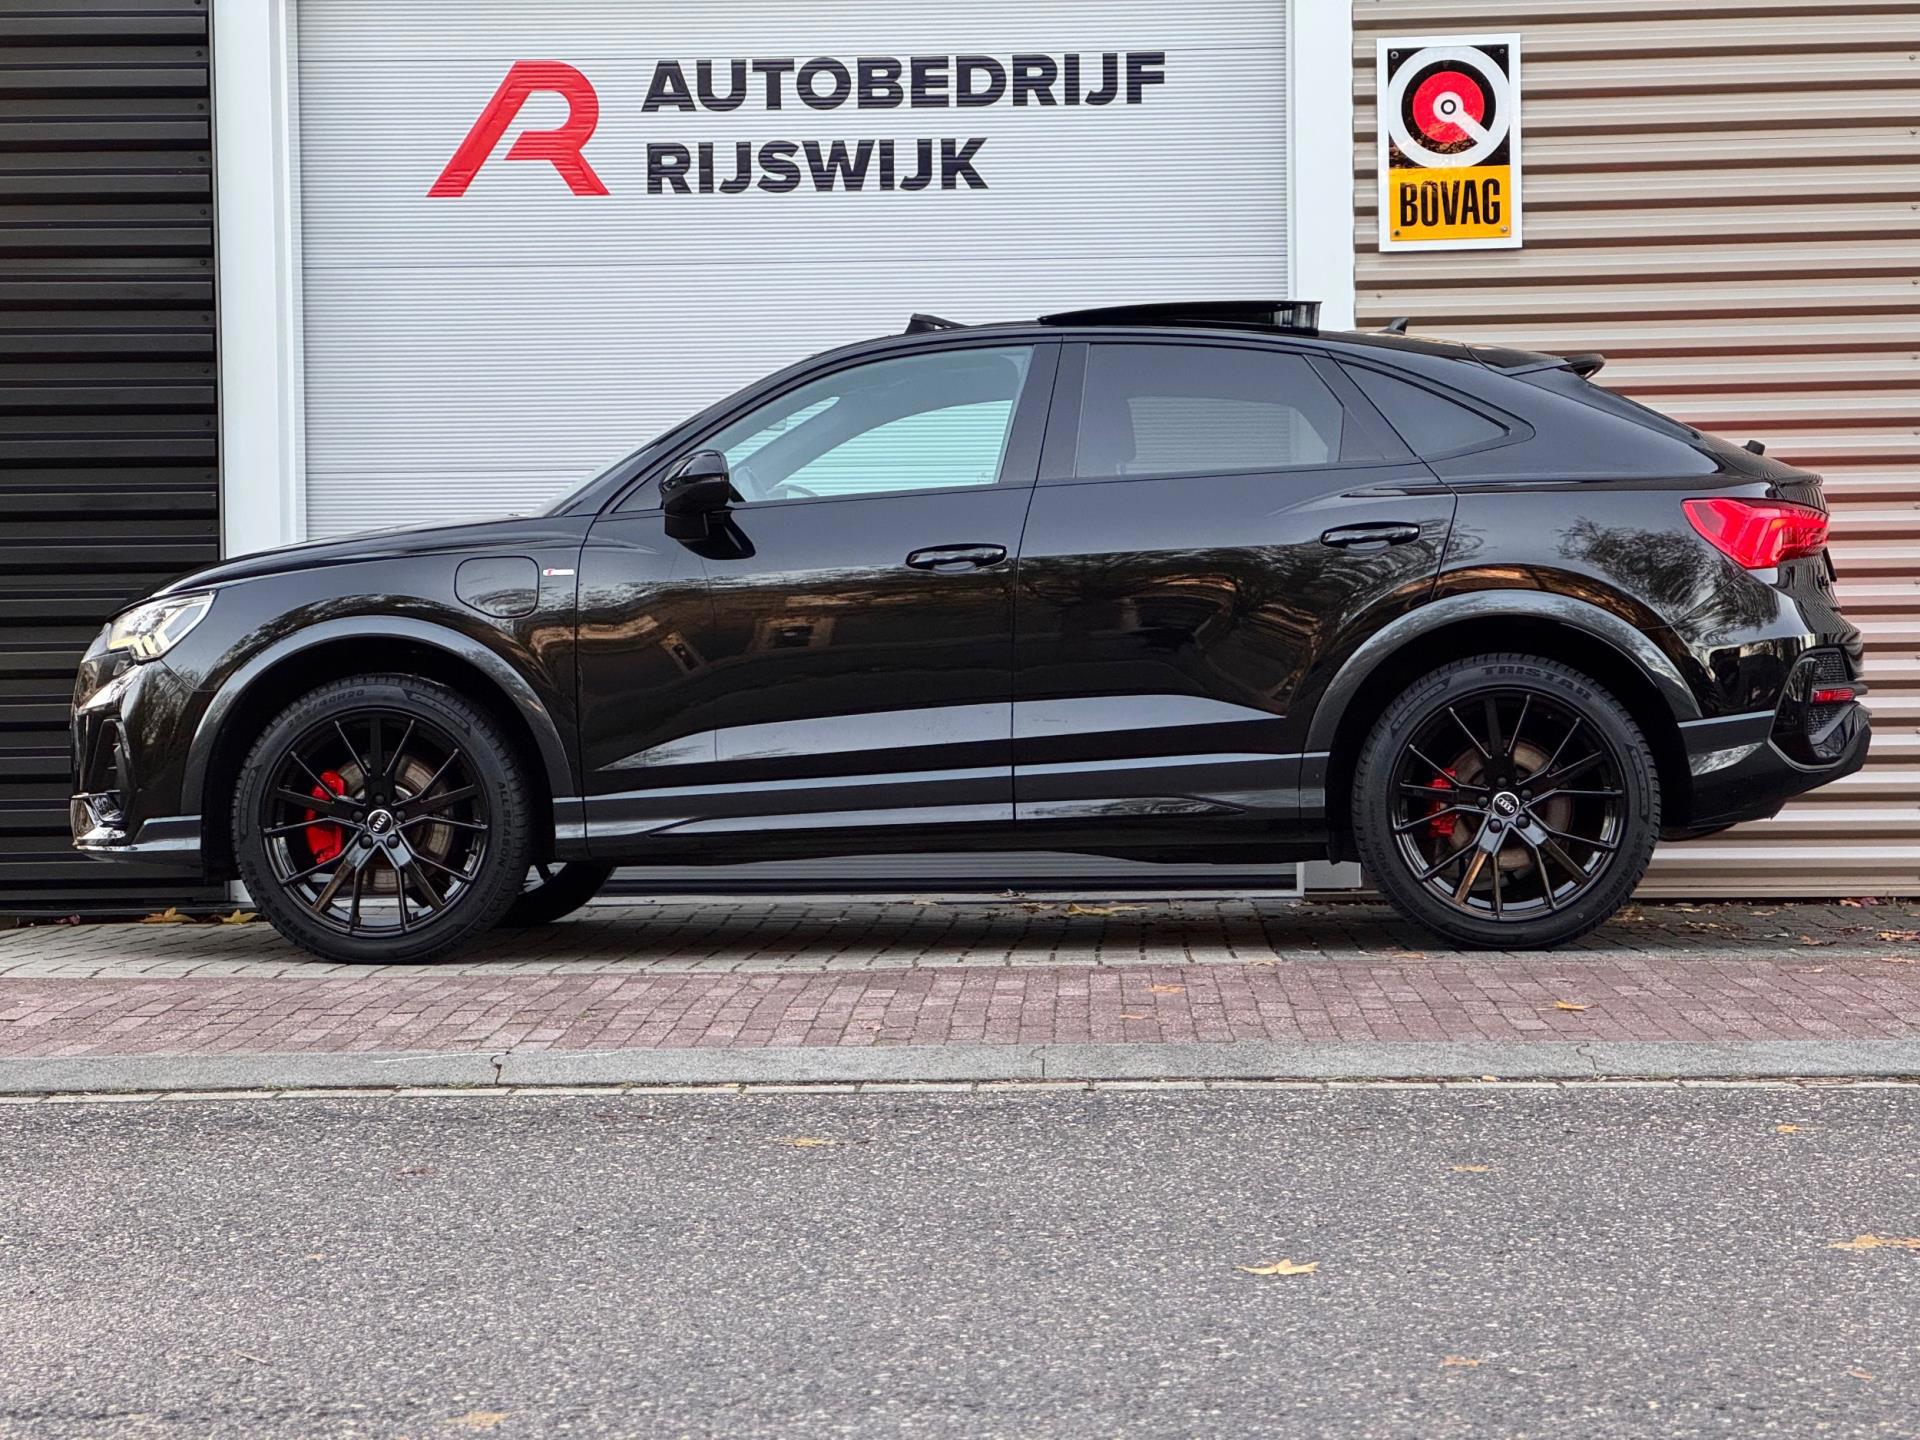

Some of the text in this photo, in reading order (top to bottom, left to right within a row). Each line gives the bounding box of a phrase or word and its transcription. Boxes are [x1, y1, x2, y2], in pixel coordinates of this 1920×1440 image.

[641, 51, 1166, 113] AUTOBEDRIJF
[646, 136, 990, 195] RIJSWIJK
[1400, 178, 1501, 227] BOVAG
